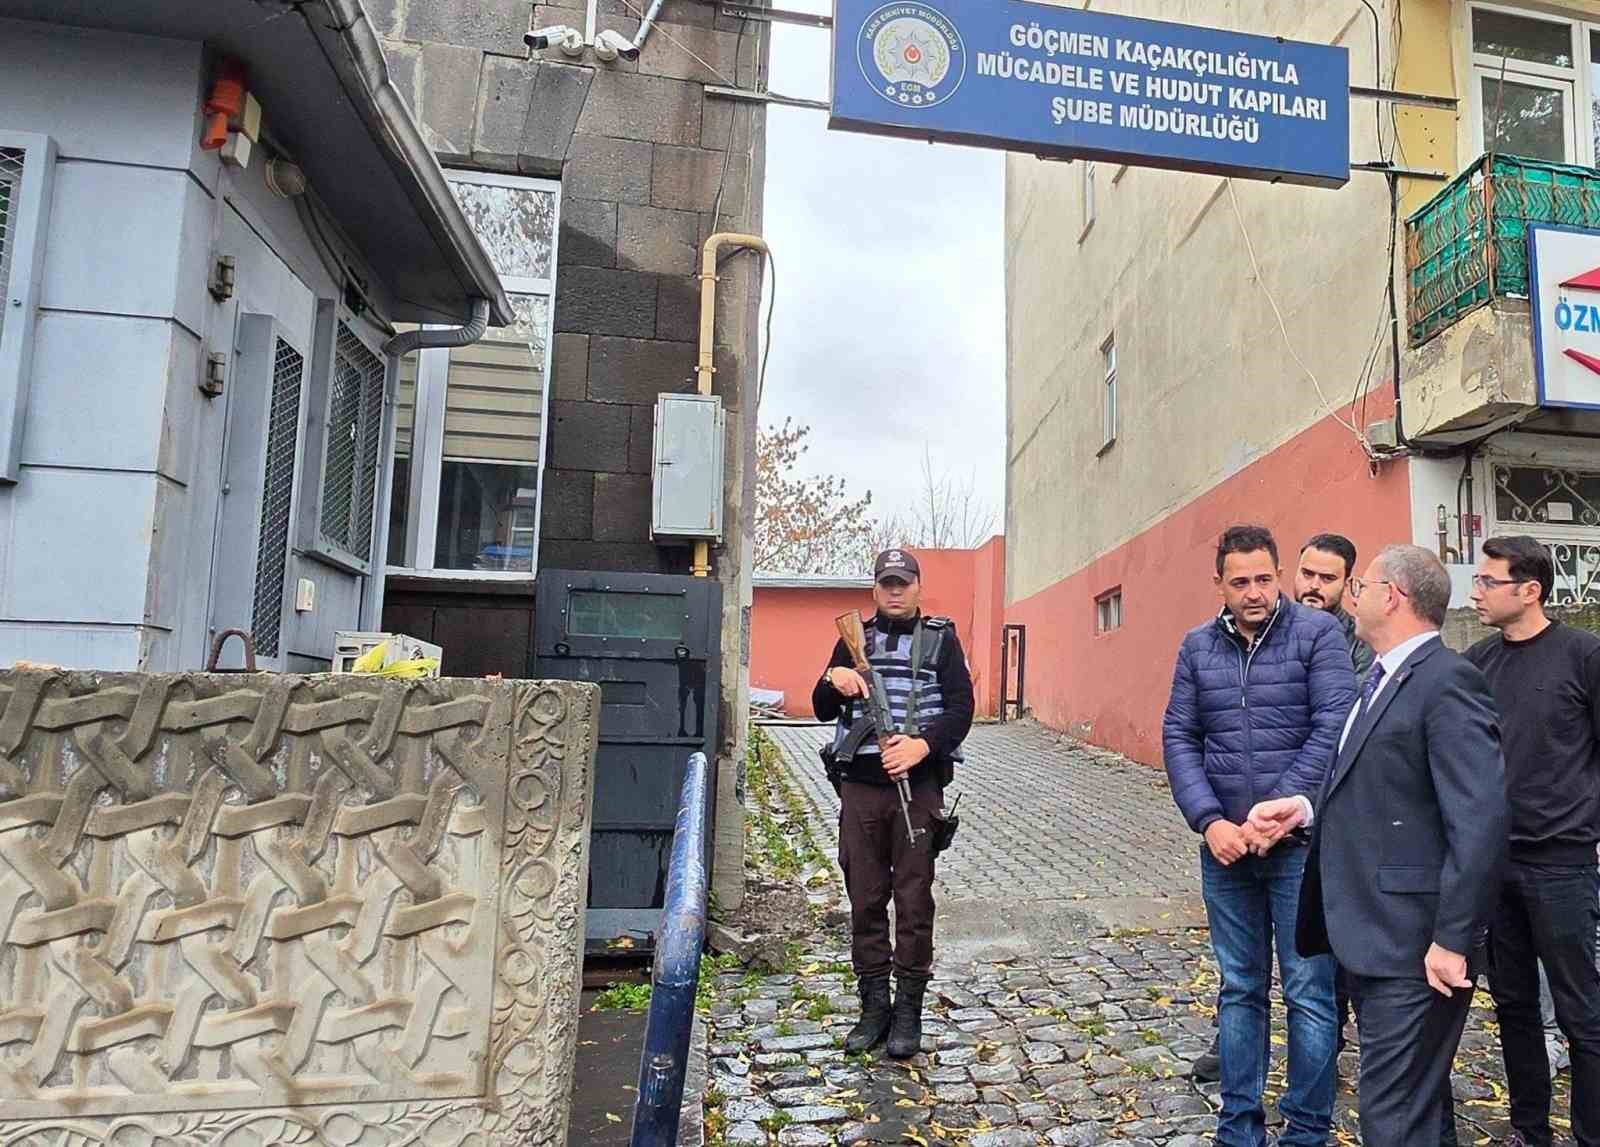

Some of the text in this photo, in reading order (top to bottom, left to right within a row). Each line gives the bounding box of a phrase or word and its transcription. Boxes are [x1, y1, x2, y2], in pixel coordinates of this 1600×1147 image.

[976, 51, 1328, 121] MÜCADELE VE HUDUT KAPILARI
[1009, 22, 1299, 86] GÖÇMEN KAÇAKÇILIĞIYLA
[1051, 96, 1260, 144] ŞUBE MÜDÜRLÜĞÜ
